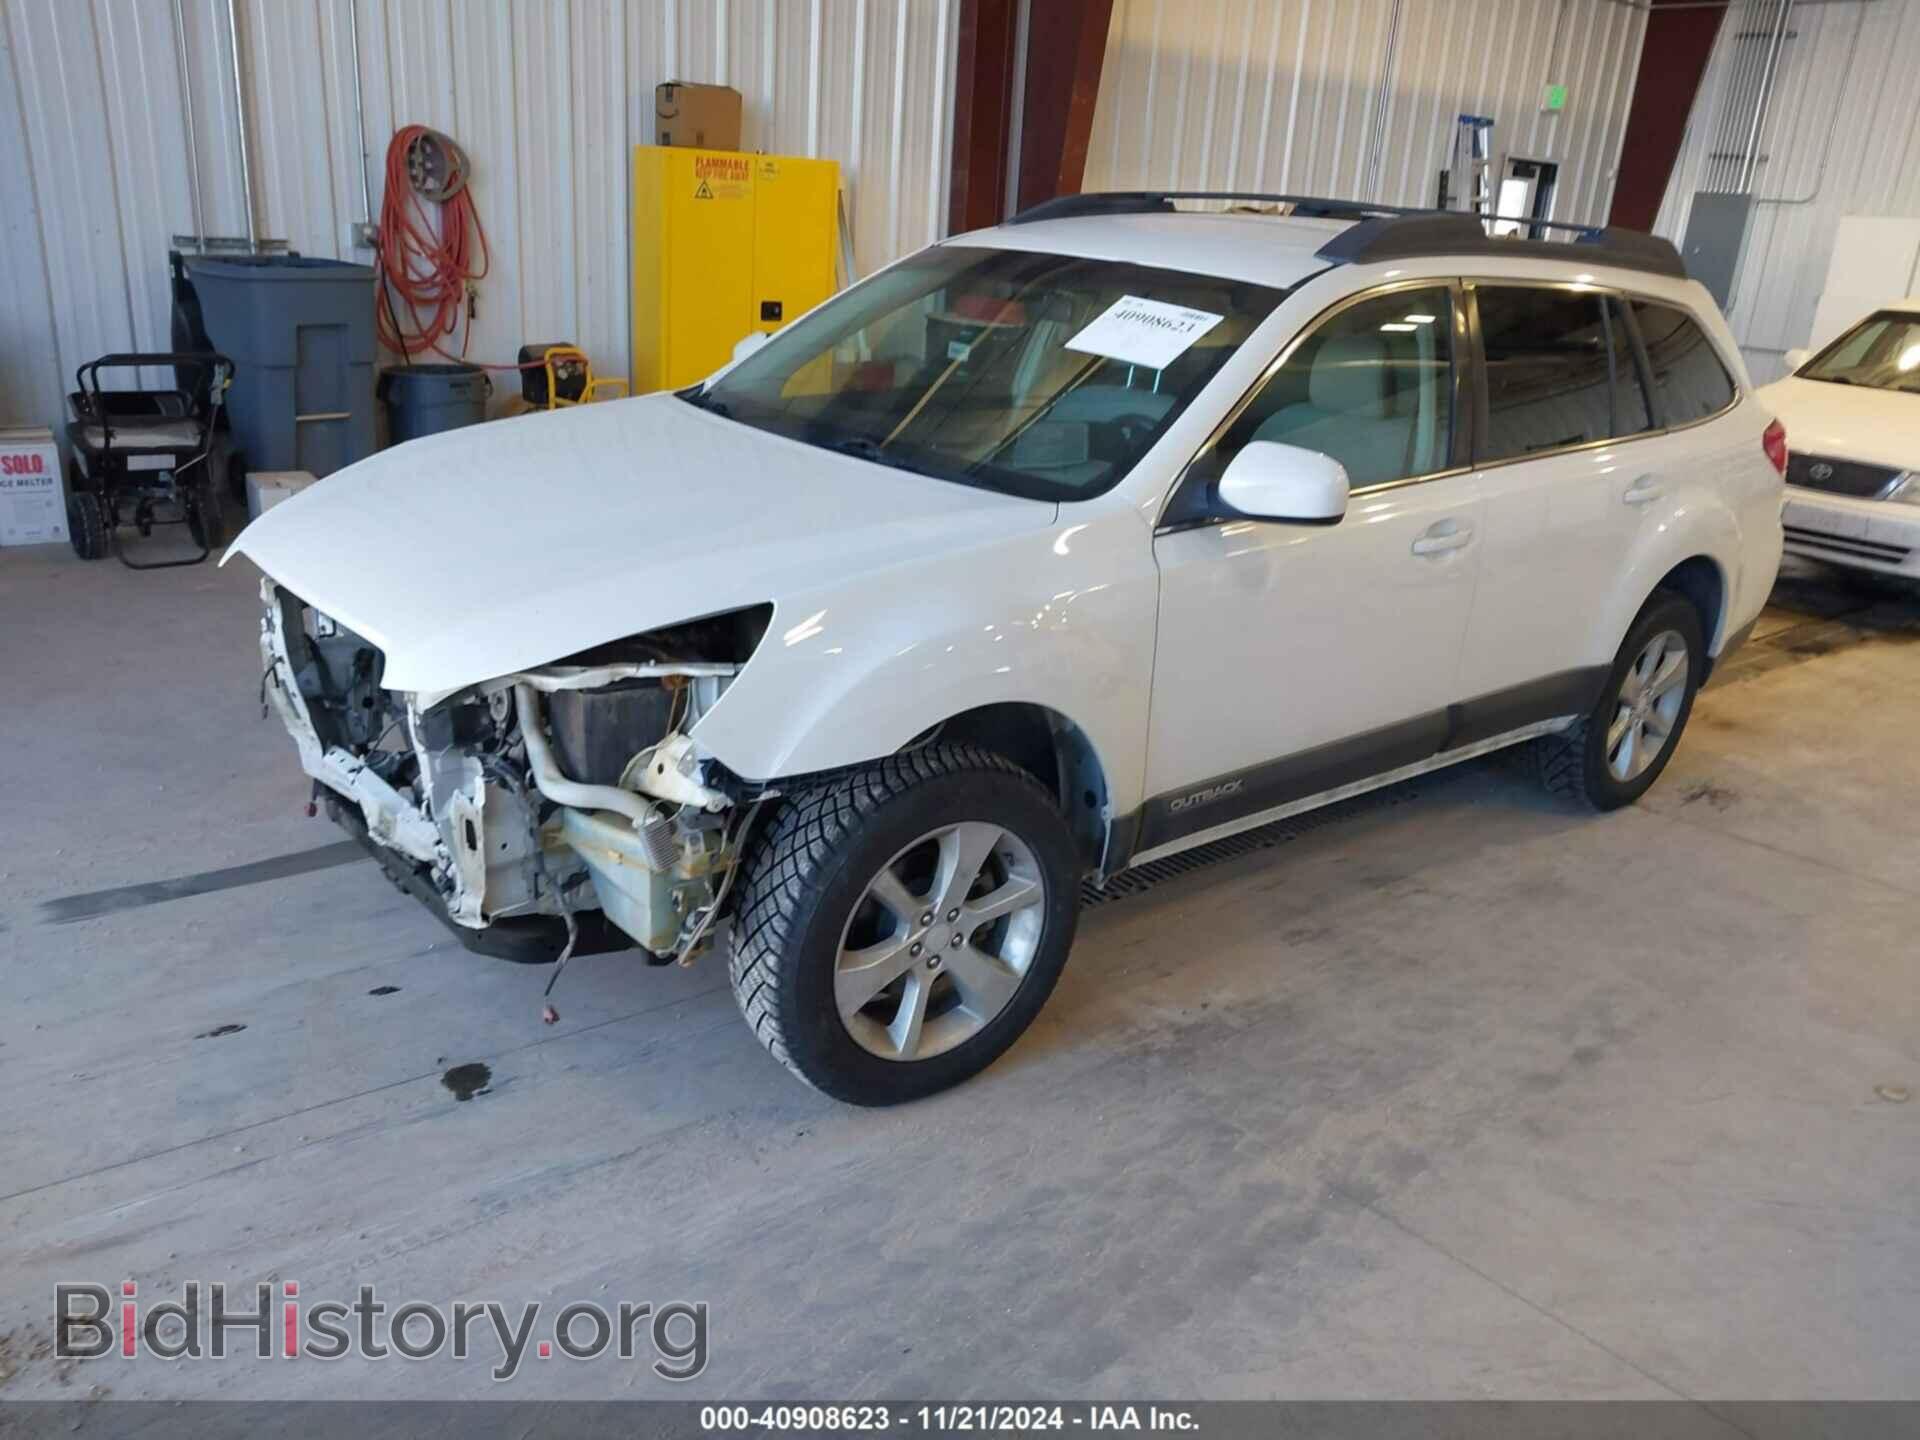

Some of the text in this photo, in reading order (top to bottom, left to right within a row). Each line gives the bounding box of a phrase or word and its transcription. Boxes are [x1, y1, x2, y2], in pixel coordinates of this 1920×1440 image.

[695, 156, 749, 171] FLAMMABLE
[1, 454, 43, 475] SOLO
[17, 478, 53, 487] MELTER
[1170, 777, 1243, 810] OUTBACK
